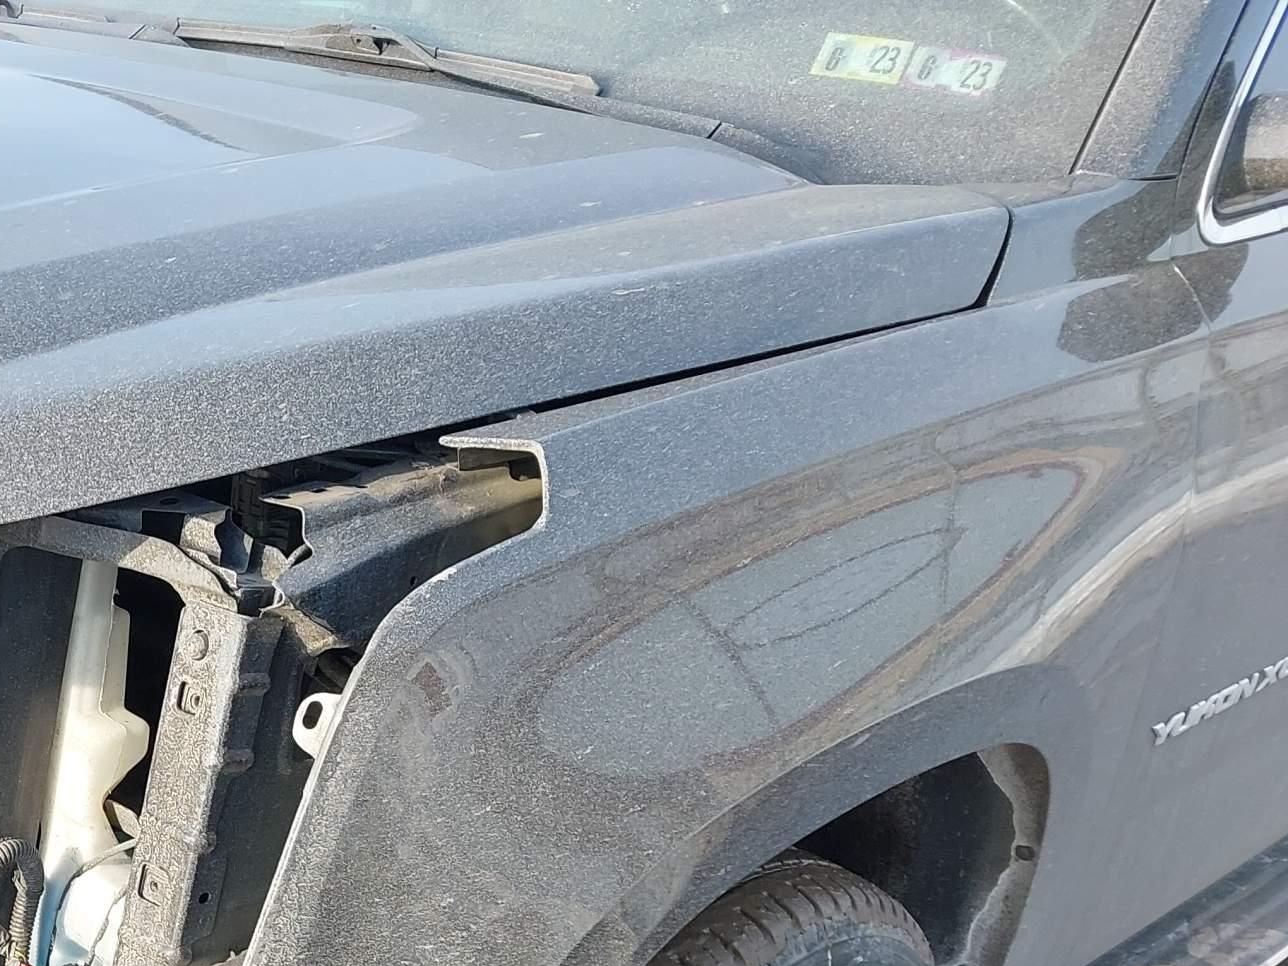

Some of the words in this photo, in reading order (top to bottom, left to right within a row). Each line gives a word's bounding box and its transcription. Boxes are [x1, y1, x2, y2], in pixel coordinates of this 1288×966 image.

[869, 46, 901, 74] 23
[959, 60, 993, 90] 23
[1152, 672, 1260, 746] YUKON
